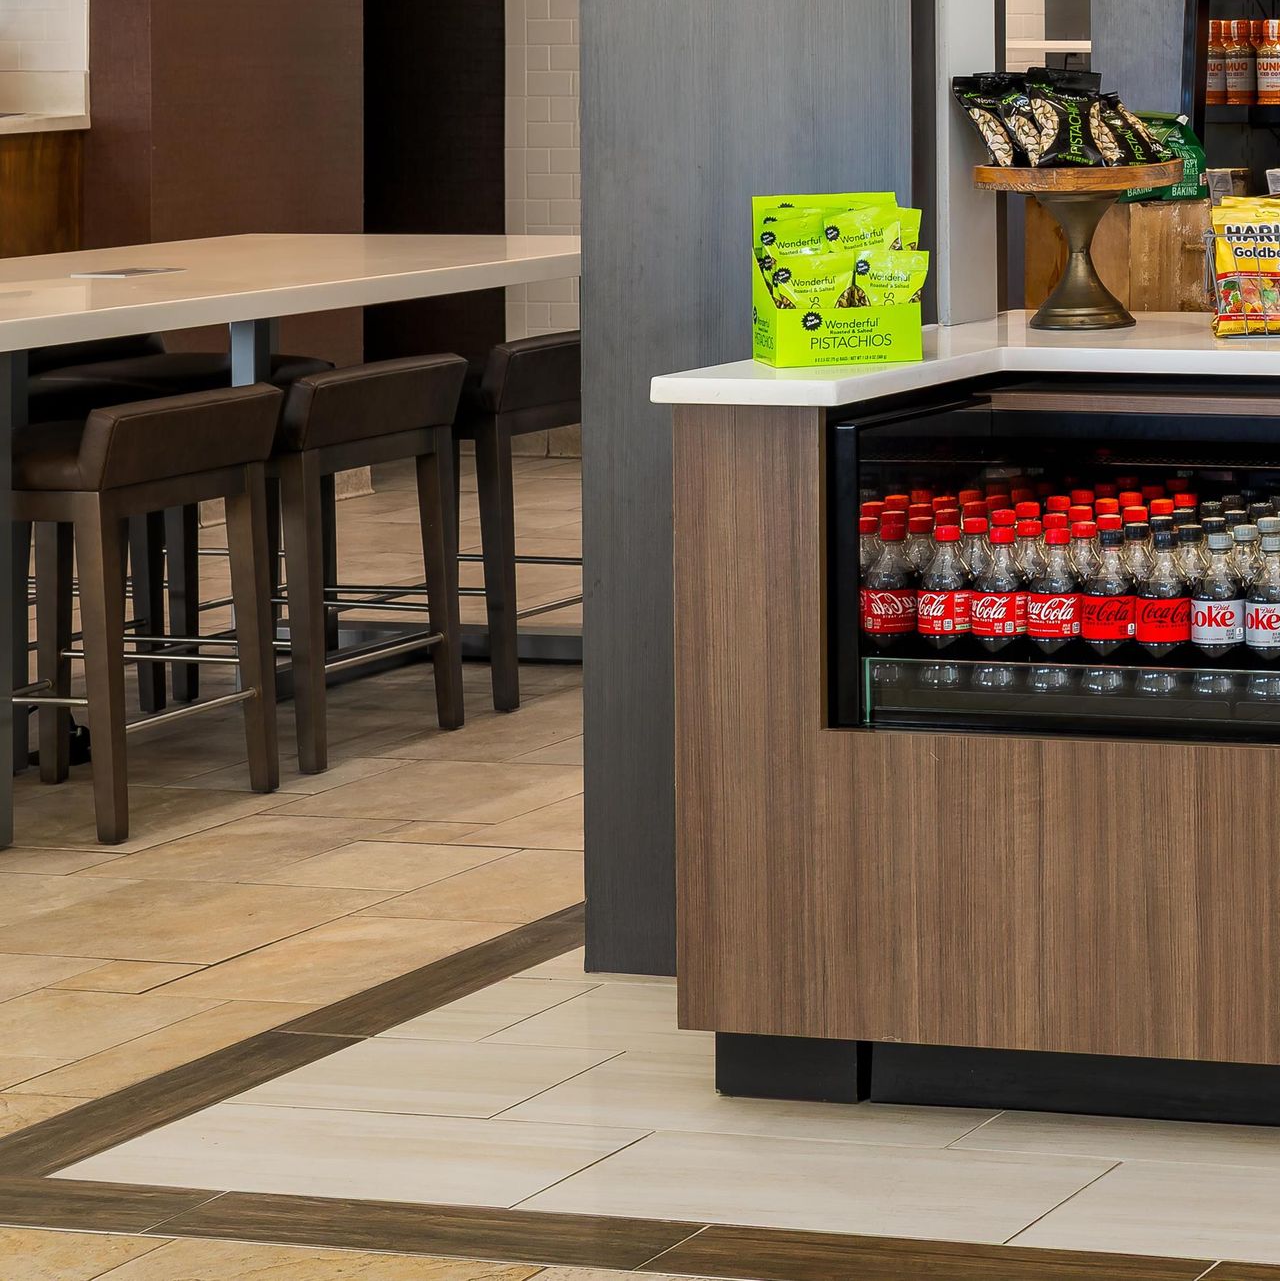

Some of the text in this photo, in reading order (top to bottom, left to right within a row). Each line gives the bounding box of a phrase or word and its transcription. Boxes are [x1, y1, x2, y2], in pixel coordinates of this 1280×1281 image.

[1172, 187, 1197, 196] BAKING
[776, 238, 821, 249] Wonderful
[791, 277, 835, 286] Wonderful
[825, 319, 879, 329] Wonderful
[810, 334, 892, 349] PISTACHIOS
[1246, 610, 1280, 630] oke
